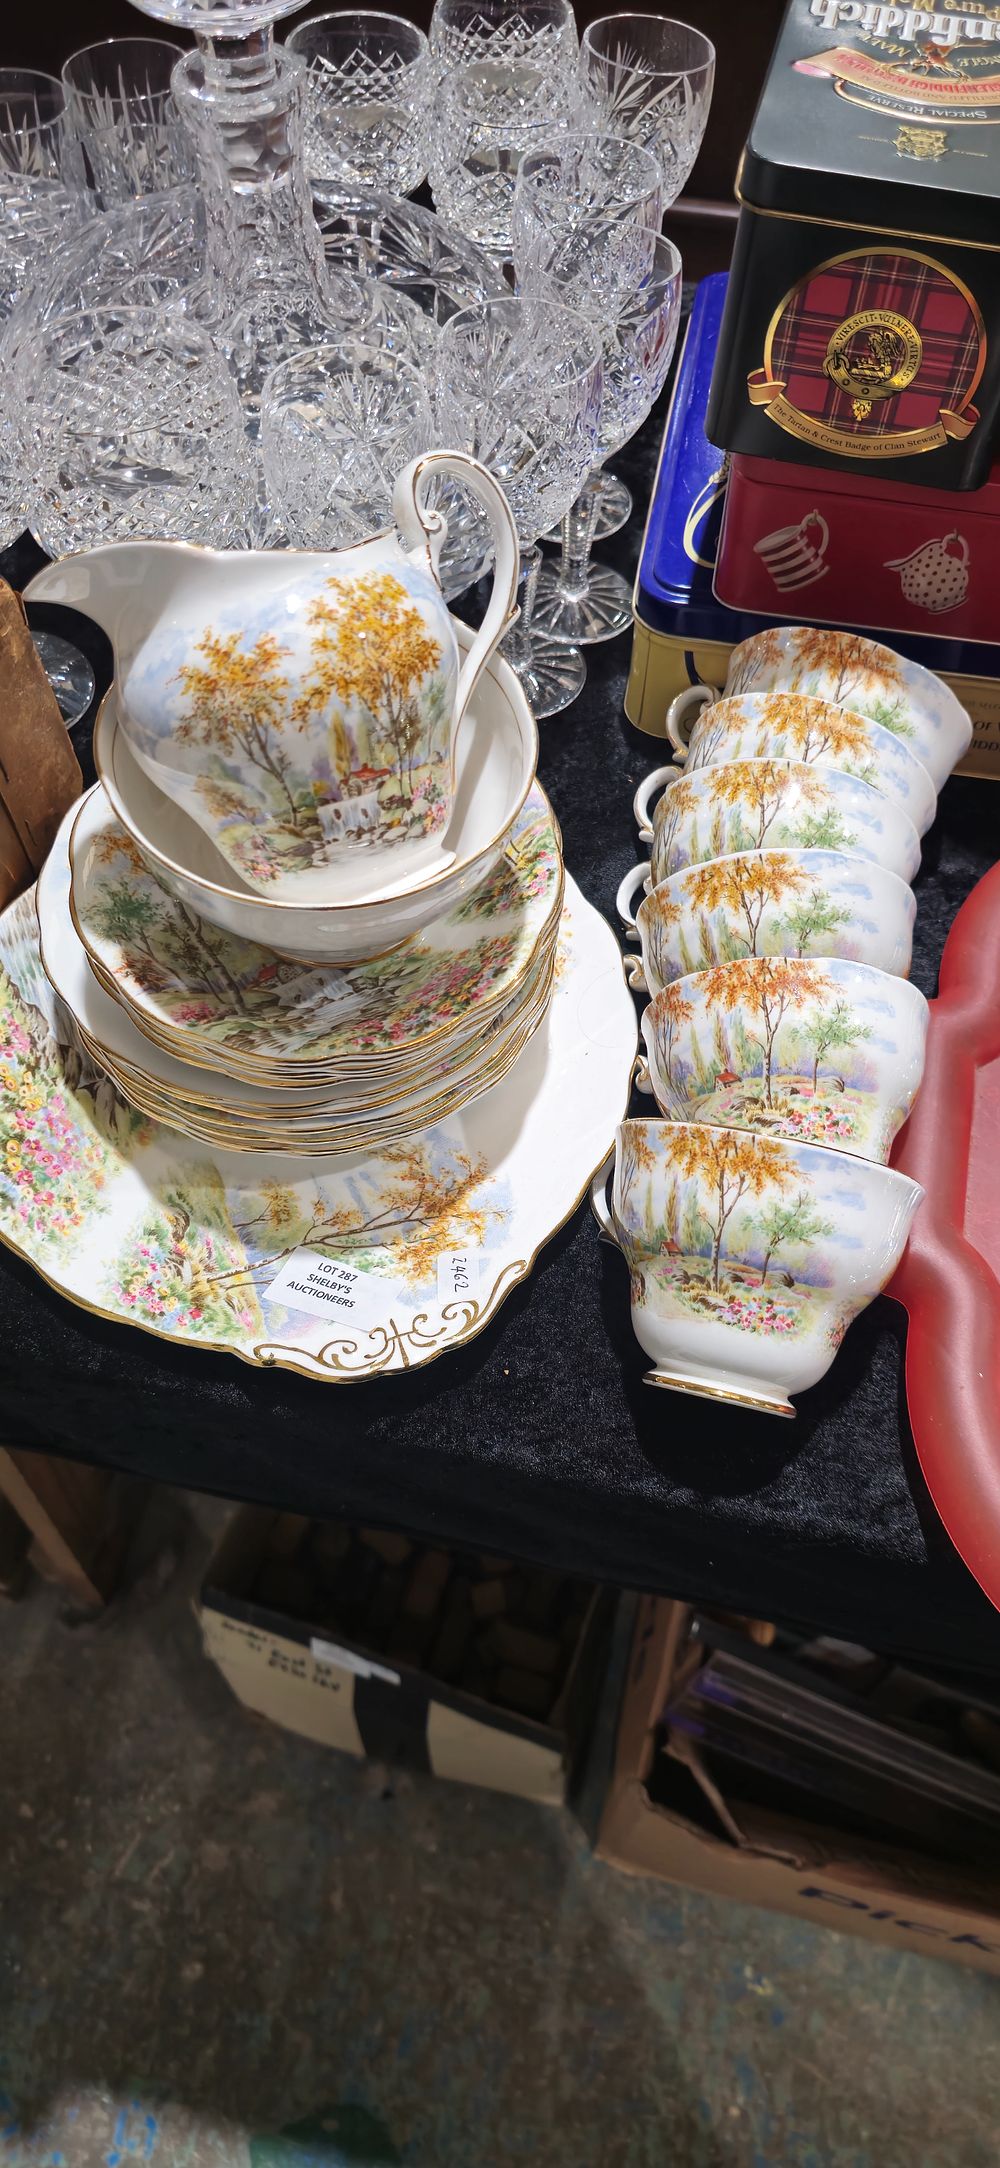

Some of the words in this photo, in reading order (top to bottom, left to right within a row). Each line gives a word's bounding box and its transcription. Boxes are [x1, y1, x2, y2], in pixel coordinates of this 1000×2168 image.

[809, 0, 1000, 46] nfiddich
[868, 95, 924, 115] RESERVE
[927, 108, 988, 119] SPECIAL
[773, 404, 787, 418] The
[787, 415, 811, 435] Tartan
[811, 430, 819, 438] &
[820, 434, 842, 447] Crest
[845, 440, 871, 451] Badge
[907, 432, 941, 447] Stewart
[307, 1273, 352, 1294] SHELBY'S
[318, 1262, 338, 1275] LOT
[338, 1270, 358, 1282] 287
[450, 1257, 469, 1293] 2462
[286, 1280, 356, 1308] AUCTIONEERS
